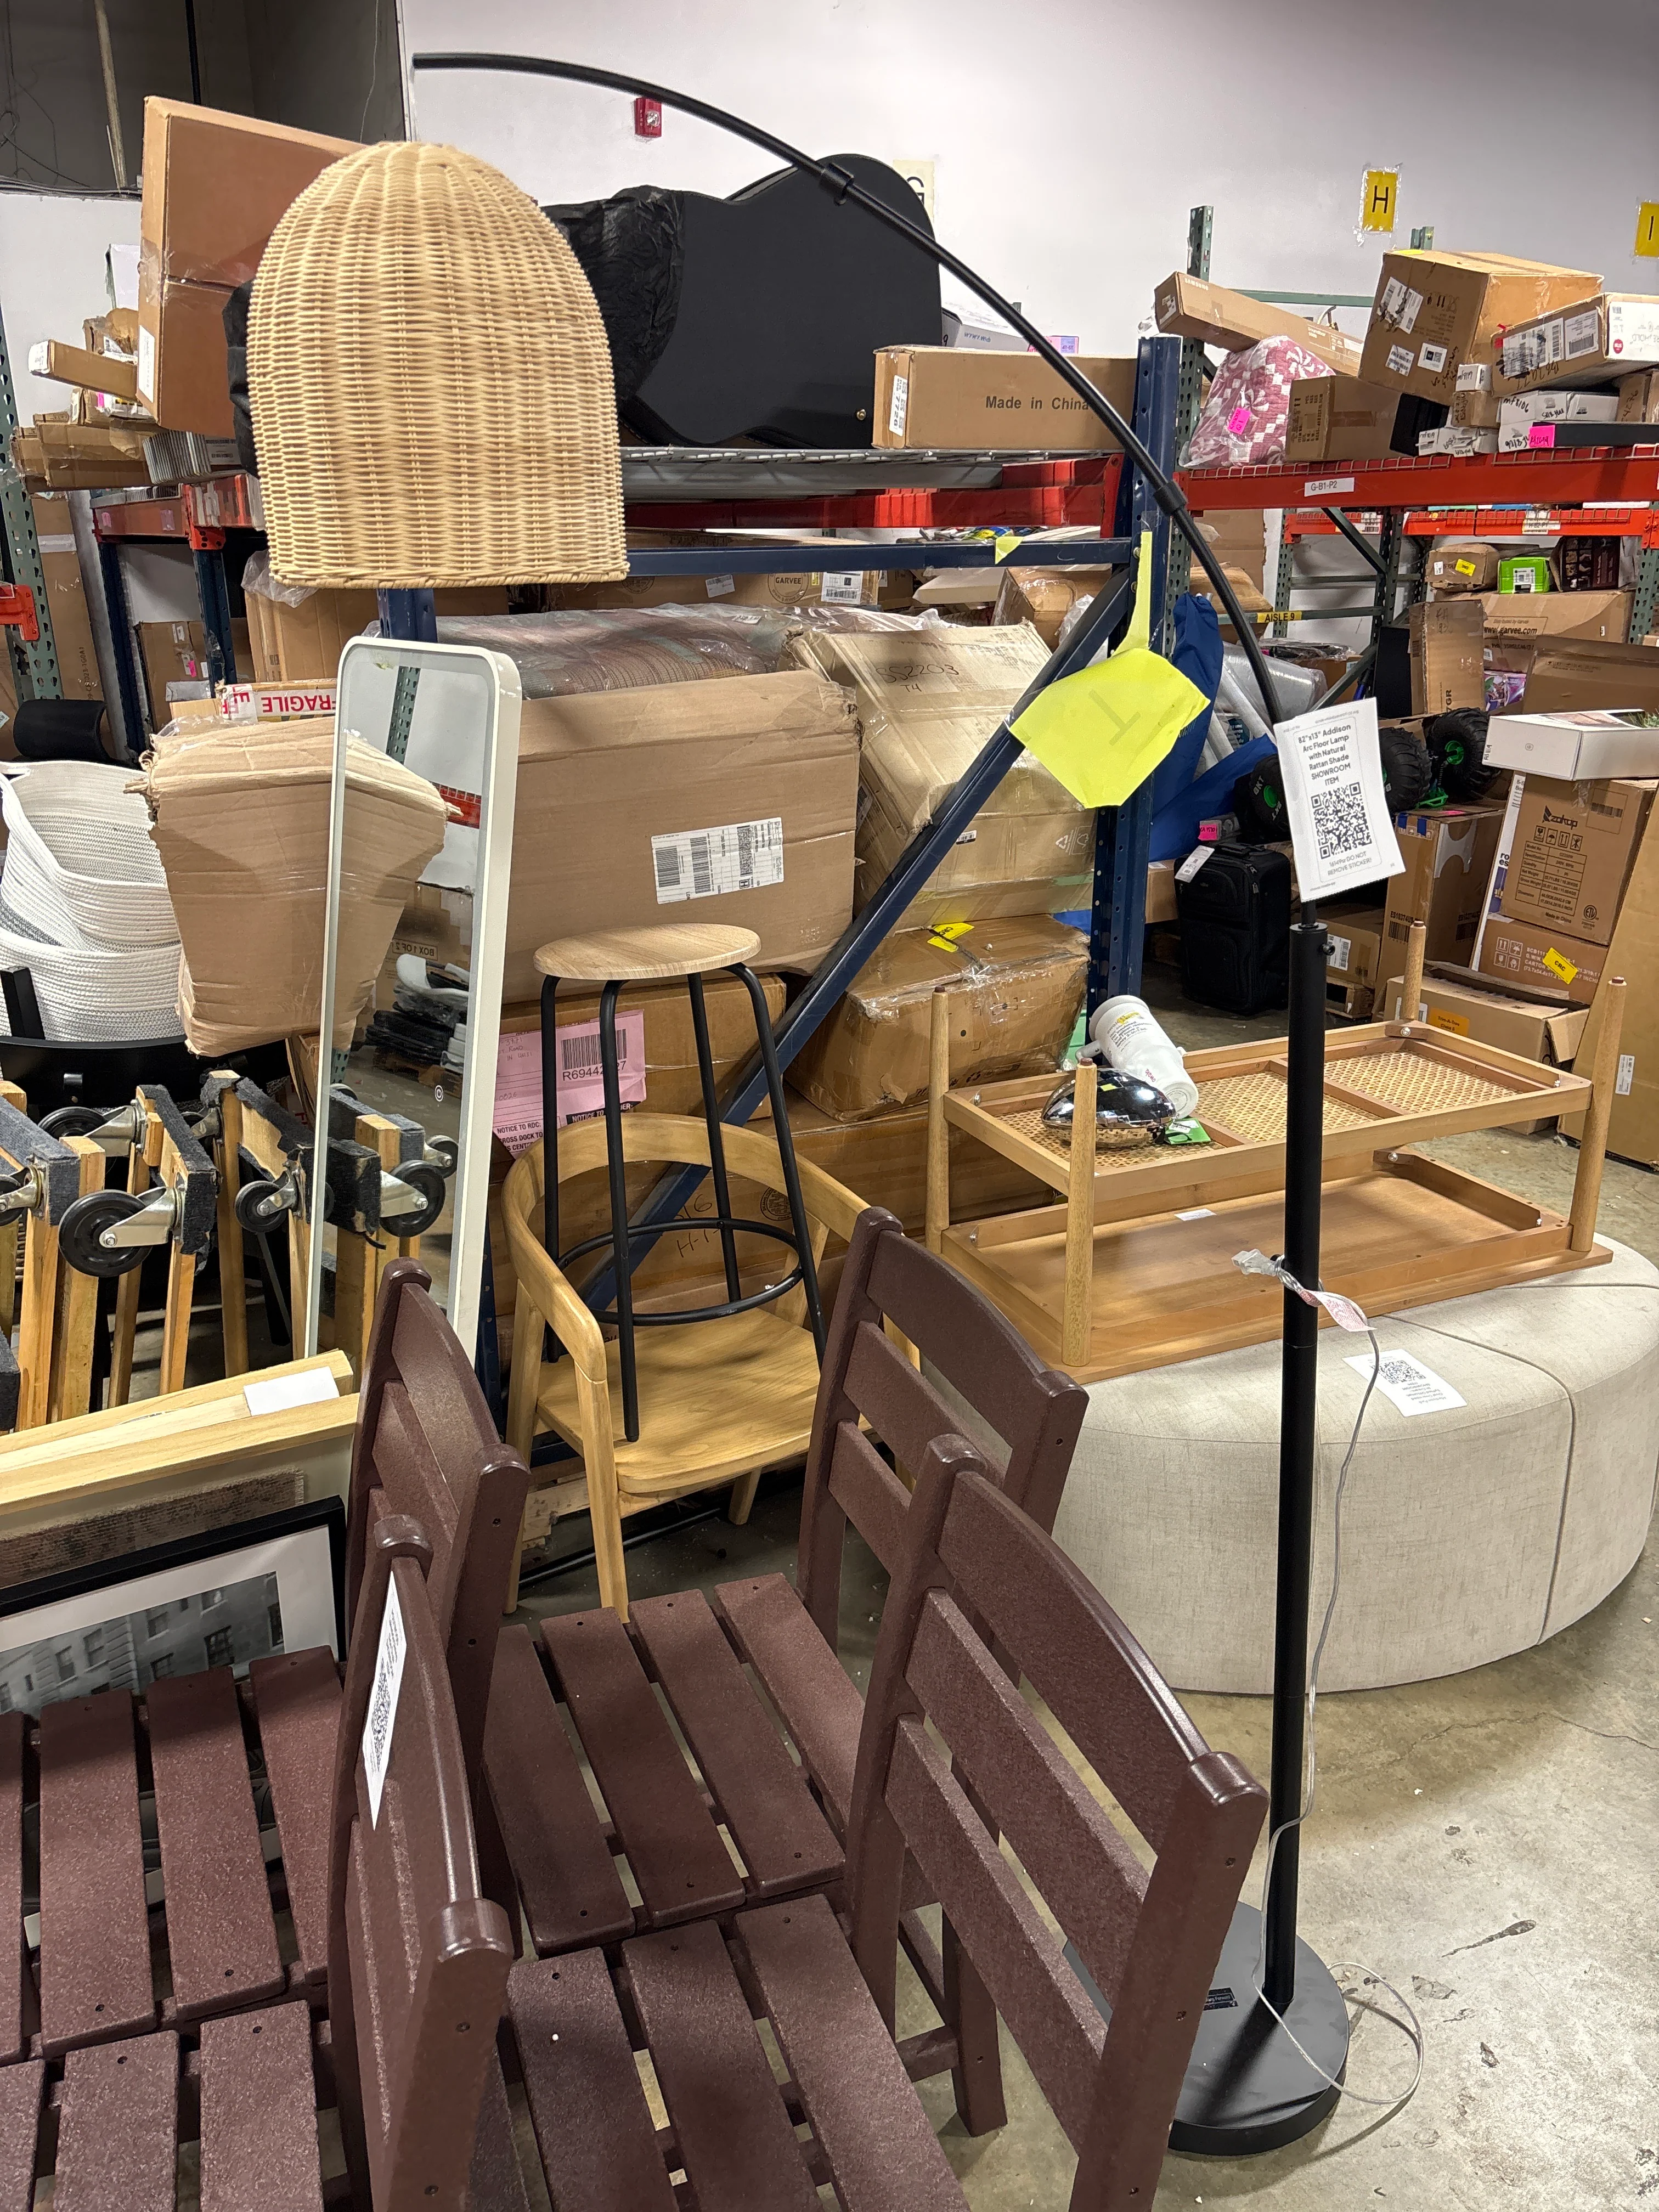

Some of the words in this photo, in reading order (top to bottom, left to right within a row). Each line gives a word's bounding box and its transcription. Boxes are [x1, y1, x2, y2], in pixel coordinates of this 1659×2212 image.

[1372, 185, 1389, 214] H
[985, 396, 1022, 409] Made
[1030, 397, 1042, 409] in
[1051, 397, 1090, 410] China
[1311, 480, 1338, 492] G-B1-P2
[775, 575, 802, 585] GARVEE
[1265, 613, 1288, 623] AISLE
[1290, 612, 1295, 620] 9
[1322, 724, 1351, 737] Addison
[1303, 744, 1313, 753] Arc
[1313, 740, 1329, 751] Floor
[1330, 735, 1350, 745] Lamp
[1308, 752, 1322, 761] with
[1322, 744, 1346, 758] Natural
[1308, 760, 1328, 771] Rattan
[1328, 754, 1350, 765] Shade
[1311, 763, 1351, 781] SHOWROOM
[1324, 776, 1339, 786] ITEM
[1355, 851, 1367, 860] NOT
[1328, 865, 1348, 876] REMOVE
[938, 927, 954, 936] CRC
[1554, 960, 1566, 972] CRC
[572, 1114, 595, 1123] NOTICE
[496, 1125, 518, 1134] NOTICE
[518, 1133, 534, 1142] DOCK
